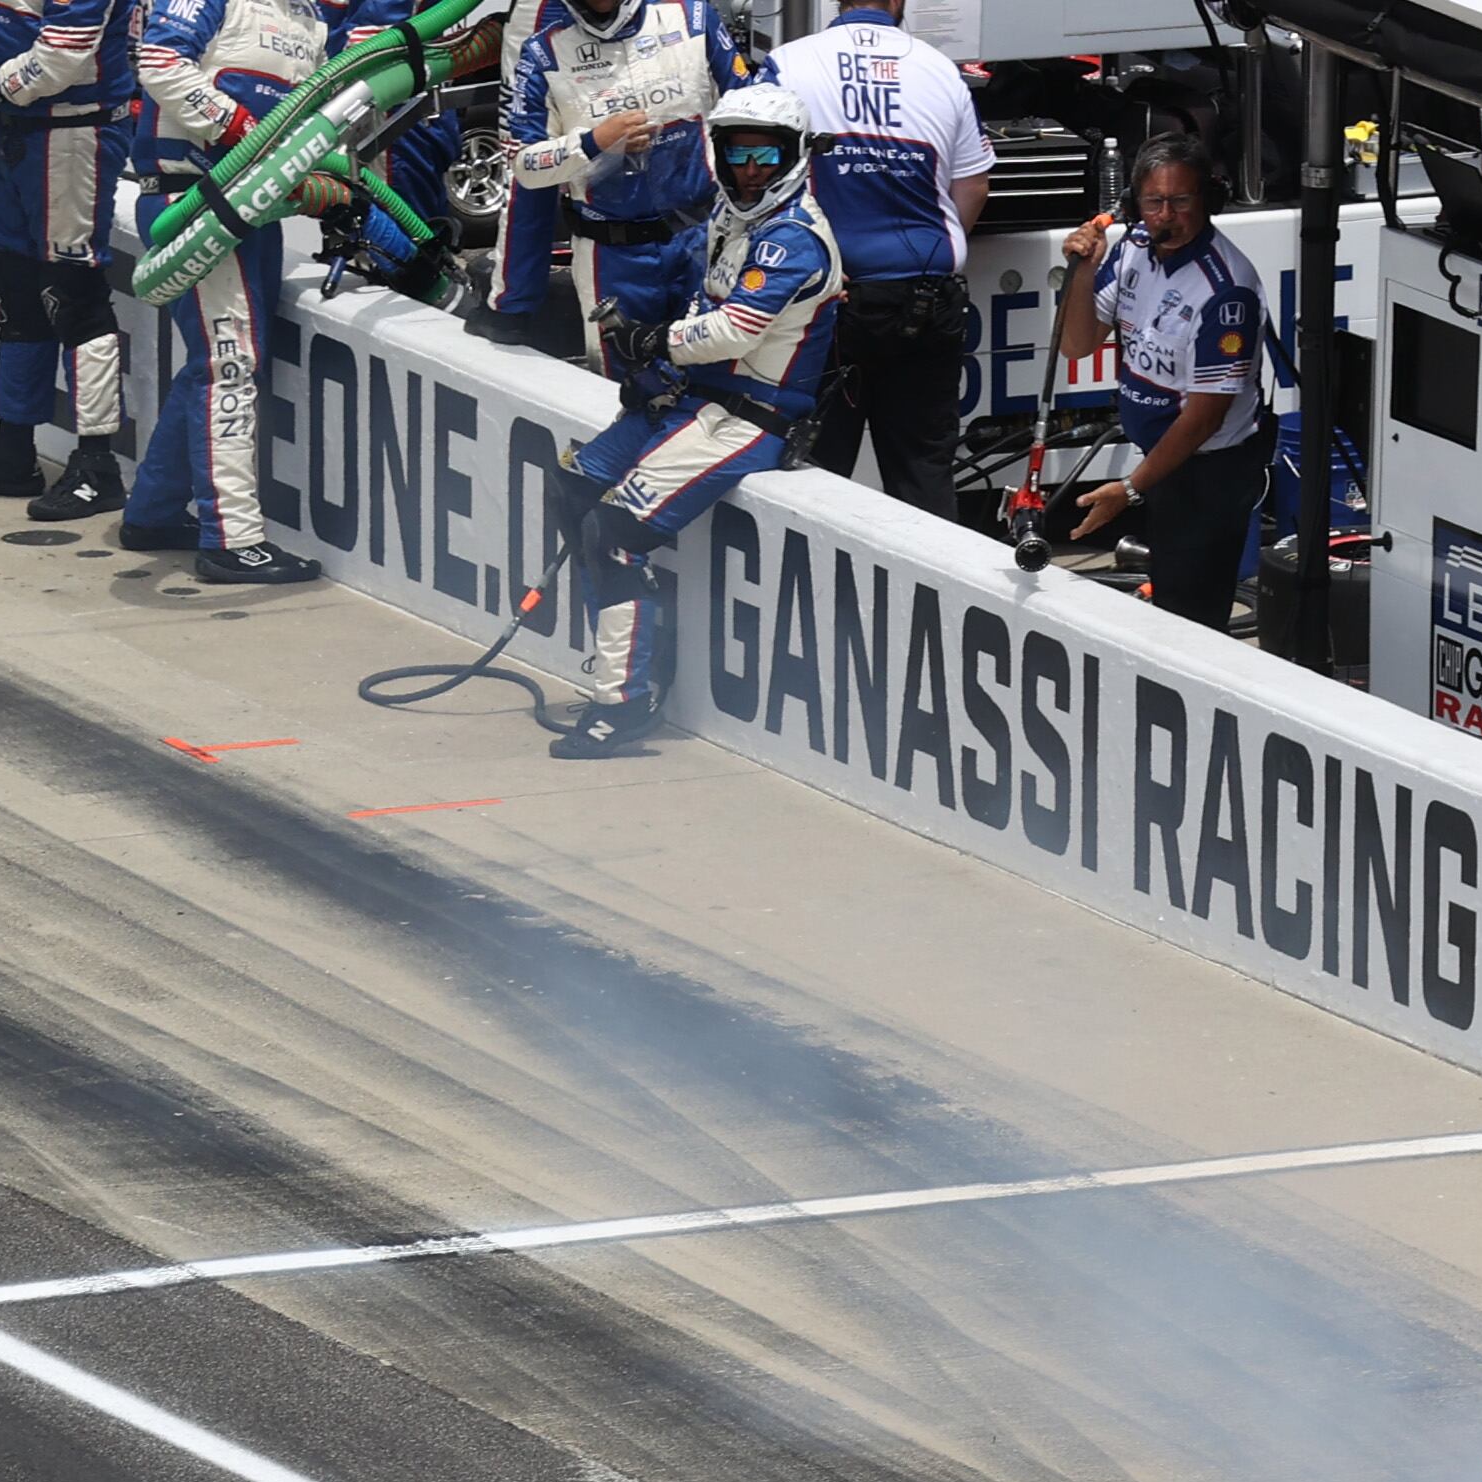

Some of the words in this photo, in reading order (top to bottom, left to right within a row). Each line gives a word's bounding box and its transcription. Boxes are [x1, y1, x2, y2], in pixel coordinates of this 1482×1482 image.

[258, 32, 315, 62] LEGION
[570, 60, 614, 74] HONDA
[837, 52, 868, 84] BE
[871, 61, 901, 80] THE
[589, 84, 686, 119] LEGION
[841, 83, 903, 128] ONE
[236, 176, 284, 224] ACE
[278, 131, 336, 183] FUEL
[523, 152, 538, 171] BE
[684, 321, 710, 343] ONE
[211, 316, 239, 439] LEGION
[1438, 638, 1463, 690] CHIP
[710, 498, 1100, 874] GANASSI
[1133, 673, 1480, 1031] RACING
